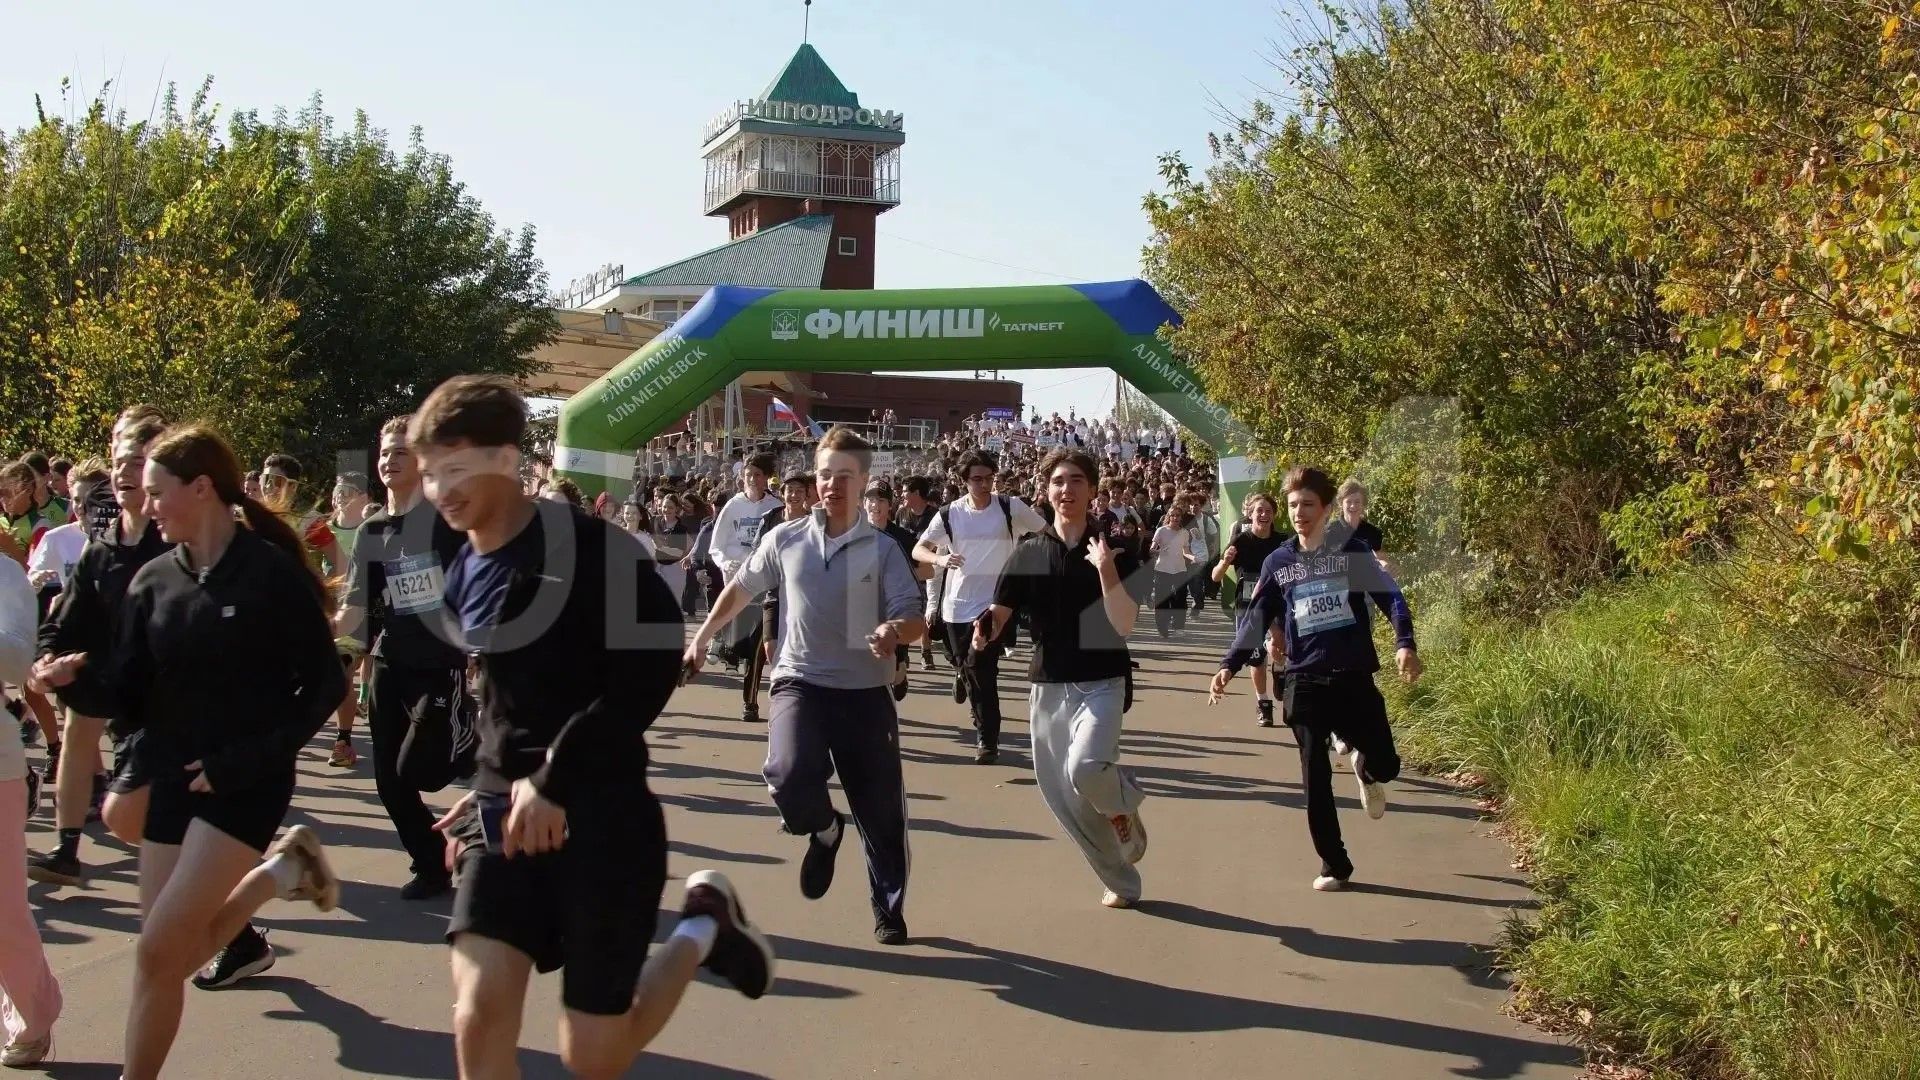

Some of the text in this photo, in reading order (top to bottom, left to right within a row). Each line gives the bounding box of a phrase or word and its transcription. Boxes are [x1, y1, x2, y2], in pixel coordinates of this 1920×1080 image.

[749, 98, 896, 130] ИППОДРОМ
[804, 308, 985, 339] ФИНИШ
[1002, 322, 1065, 332] TATNEFT
[600, 333, 686, 403] #ЛЮБИМЫЙ
[606, 345, 708, 428] АЛЬМЕТЬЕВСК
[395, 573, 432, 596] 15221
[1305, 594, 1342, 616] 15894
